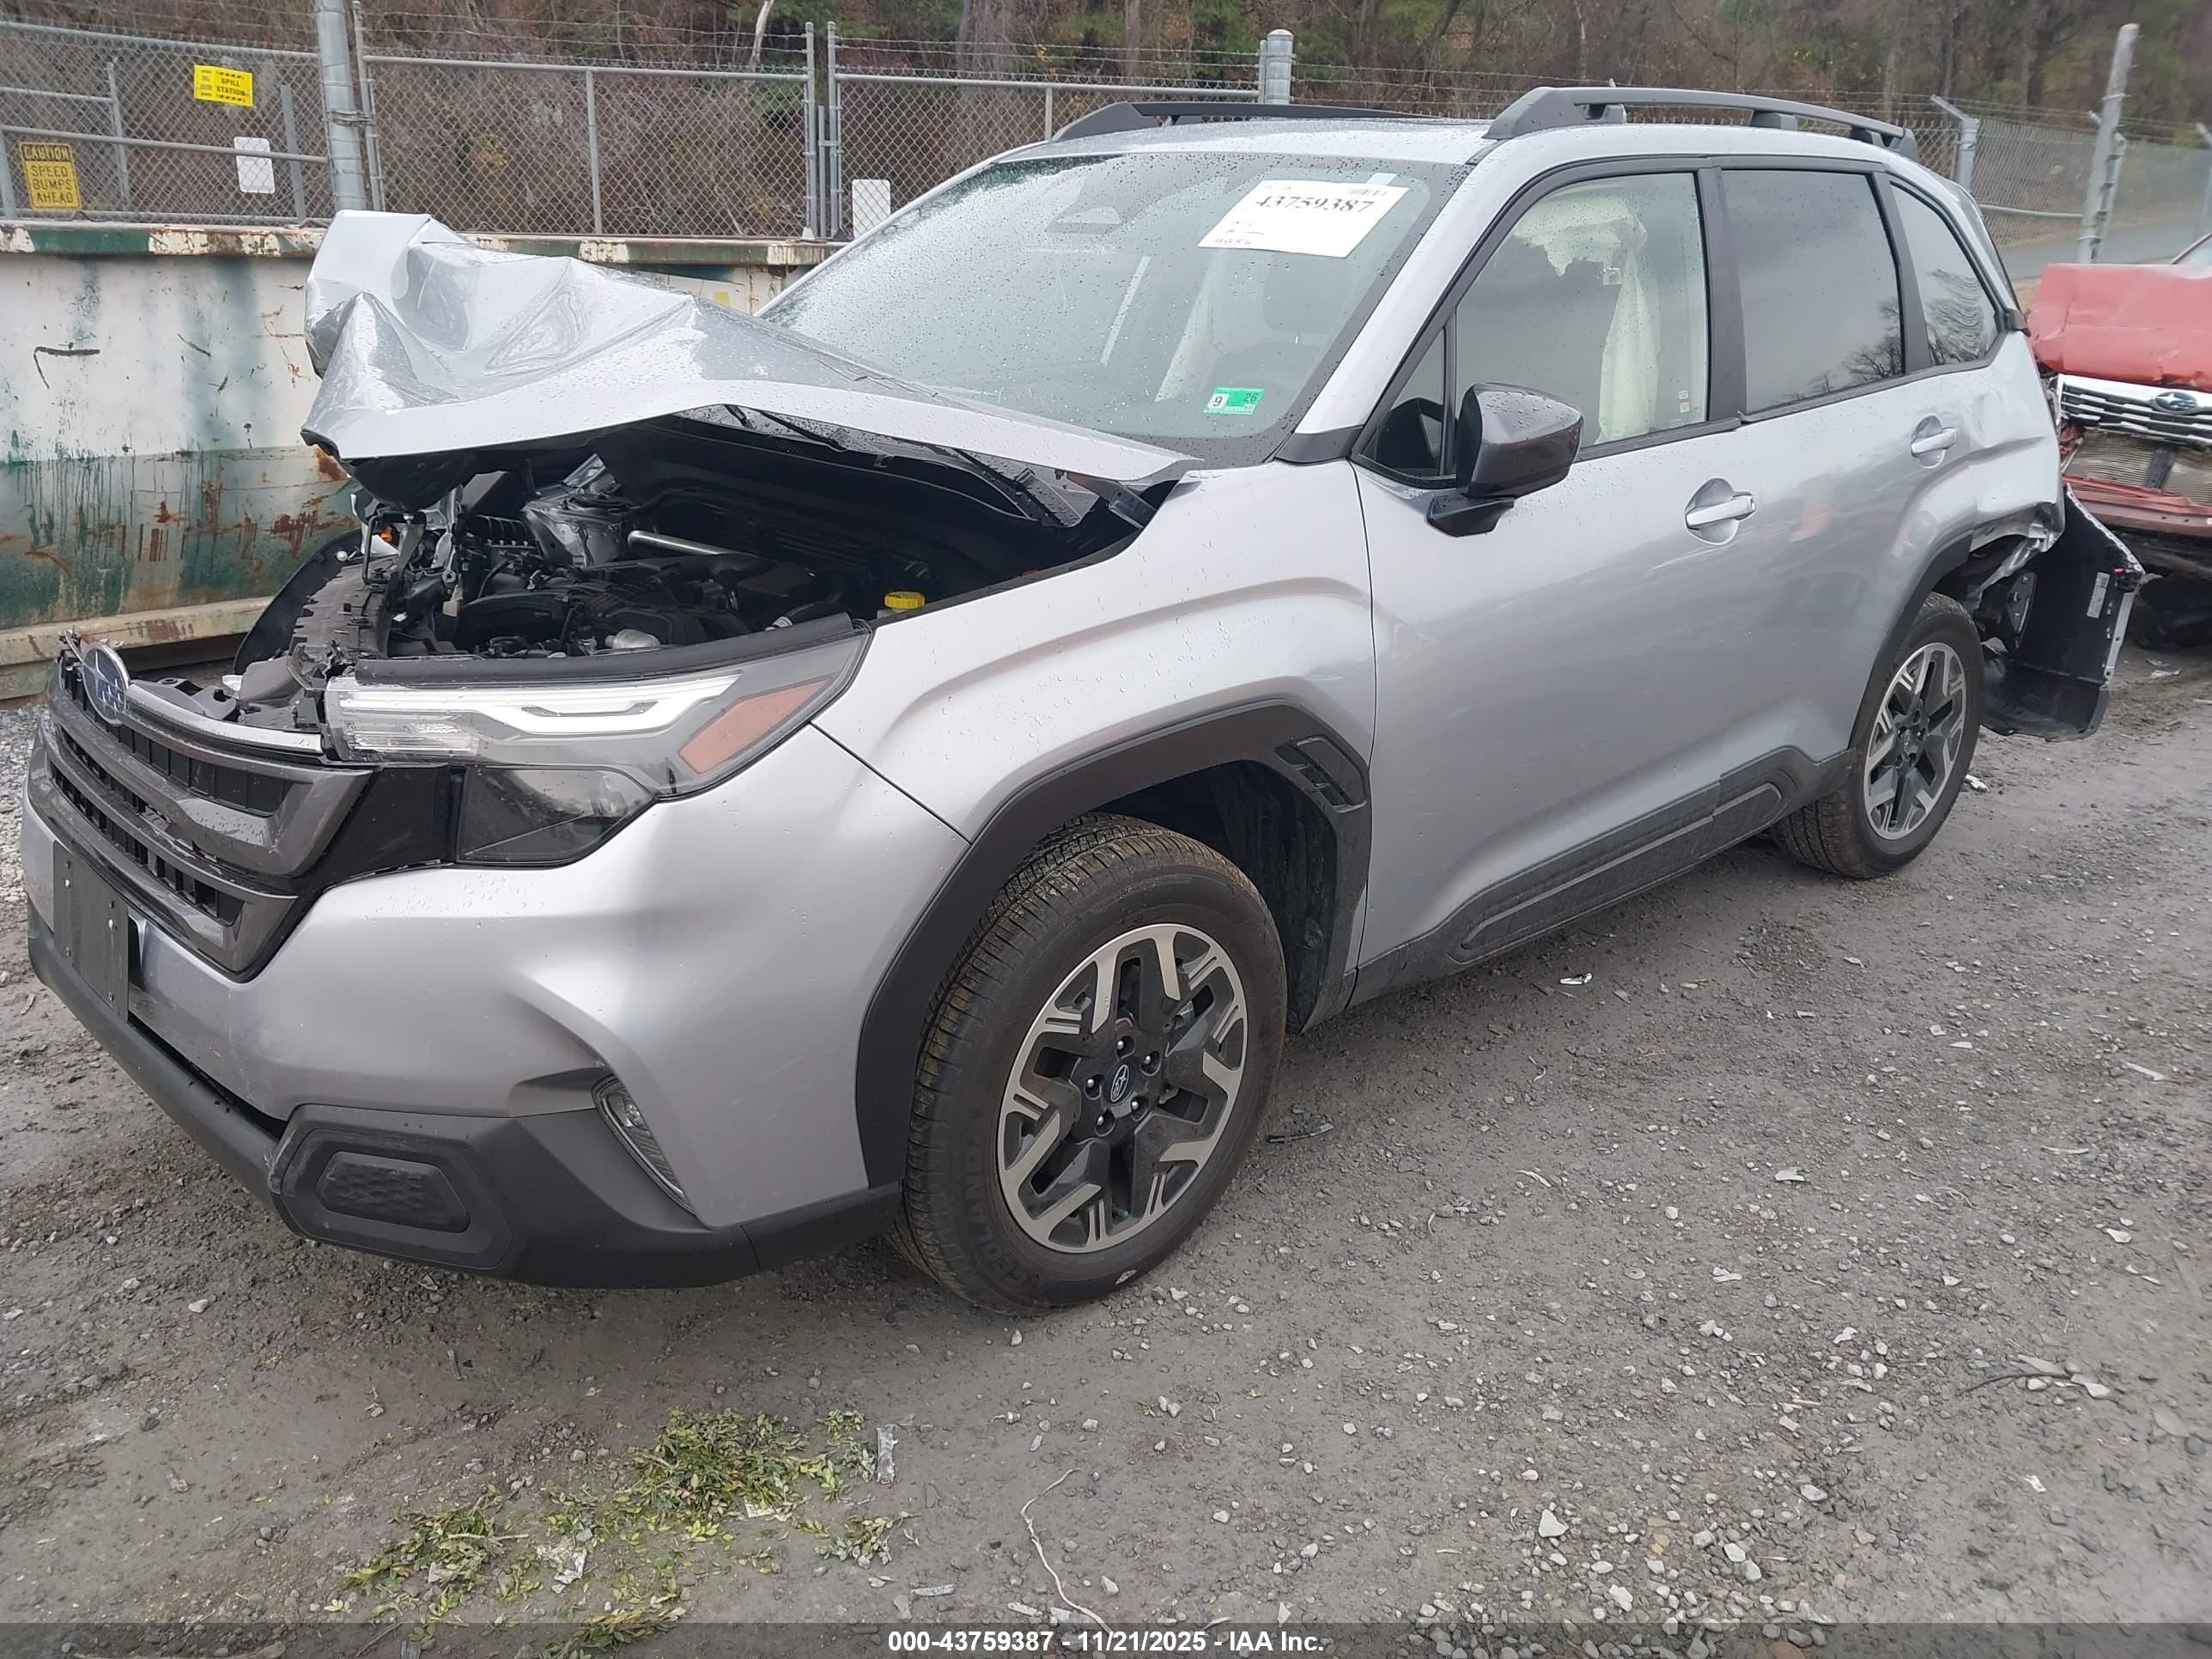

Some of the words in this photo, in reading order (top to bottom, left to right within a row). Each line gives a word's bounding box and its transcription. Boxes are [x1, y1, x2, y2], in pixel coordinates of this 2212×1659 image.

[221, 78, 240, 87] SPILL
[216, 86, 246, 96] STATION
[24, 146, 70, 160] CAUTION
[31, 166, 68, 177] SPEED
[33, 179, 72, 190] BUMPS
[37, 192, 74, 203] AHEAD
[1255, 195, 1375, 213] 43759387
[1212, 396, 1223, 407] 9
[1243, 392, 1259, 402] 26
